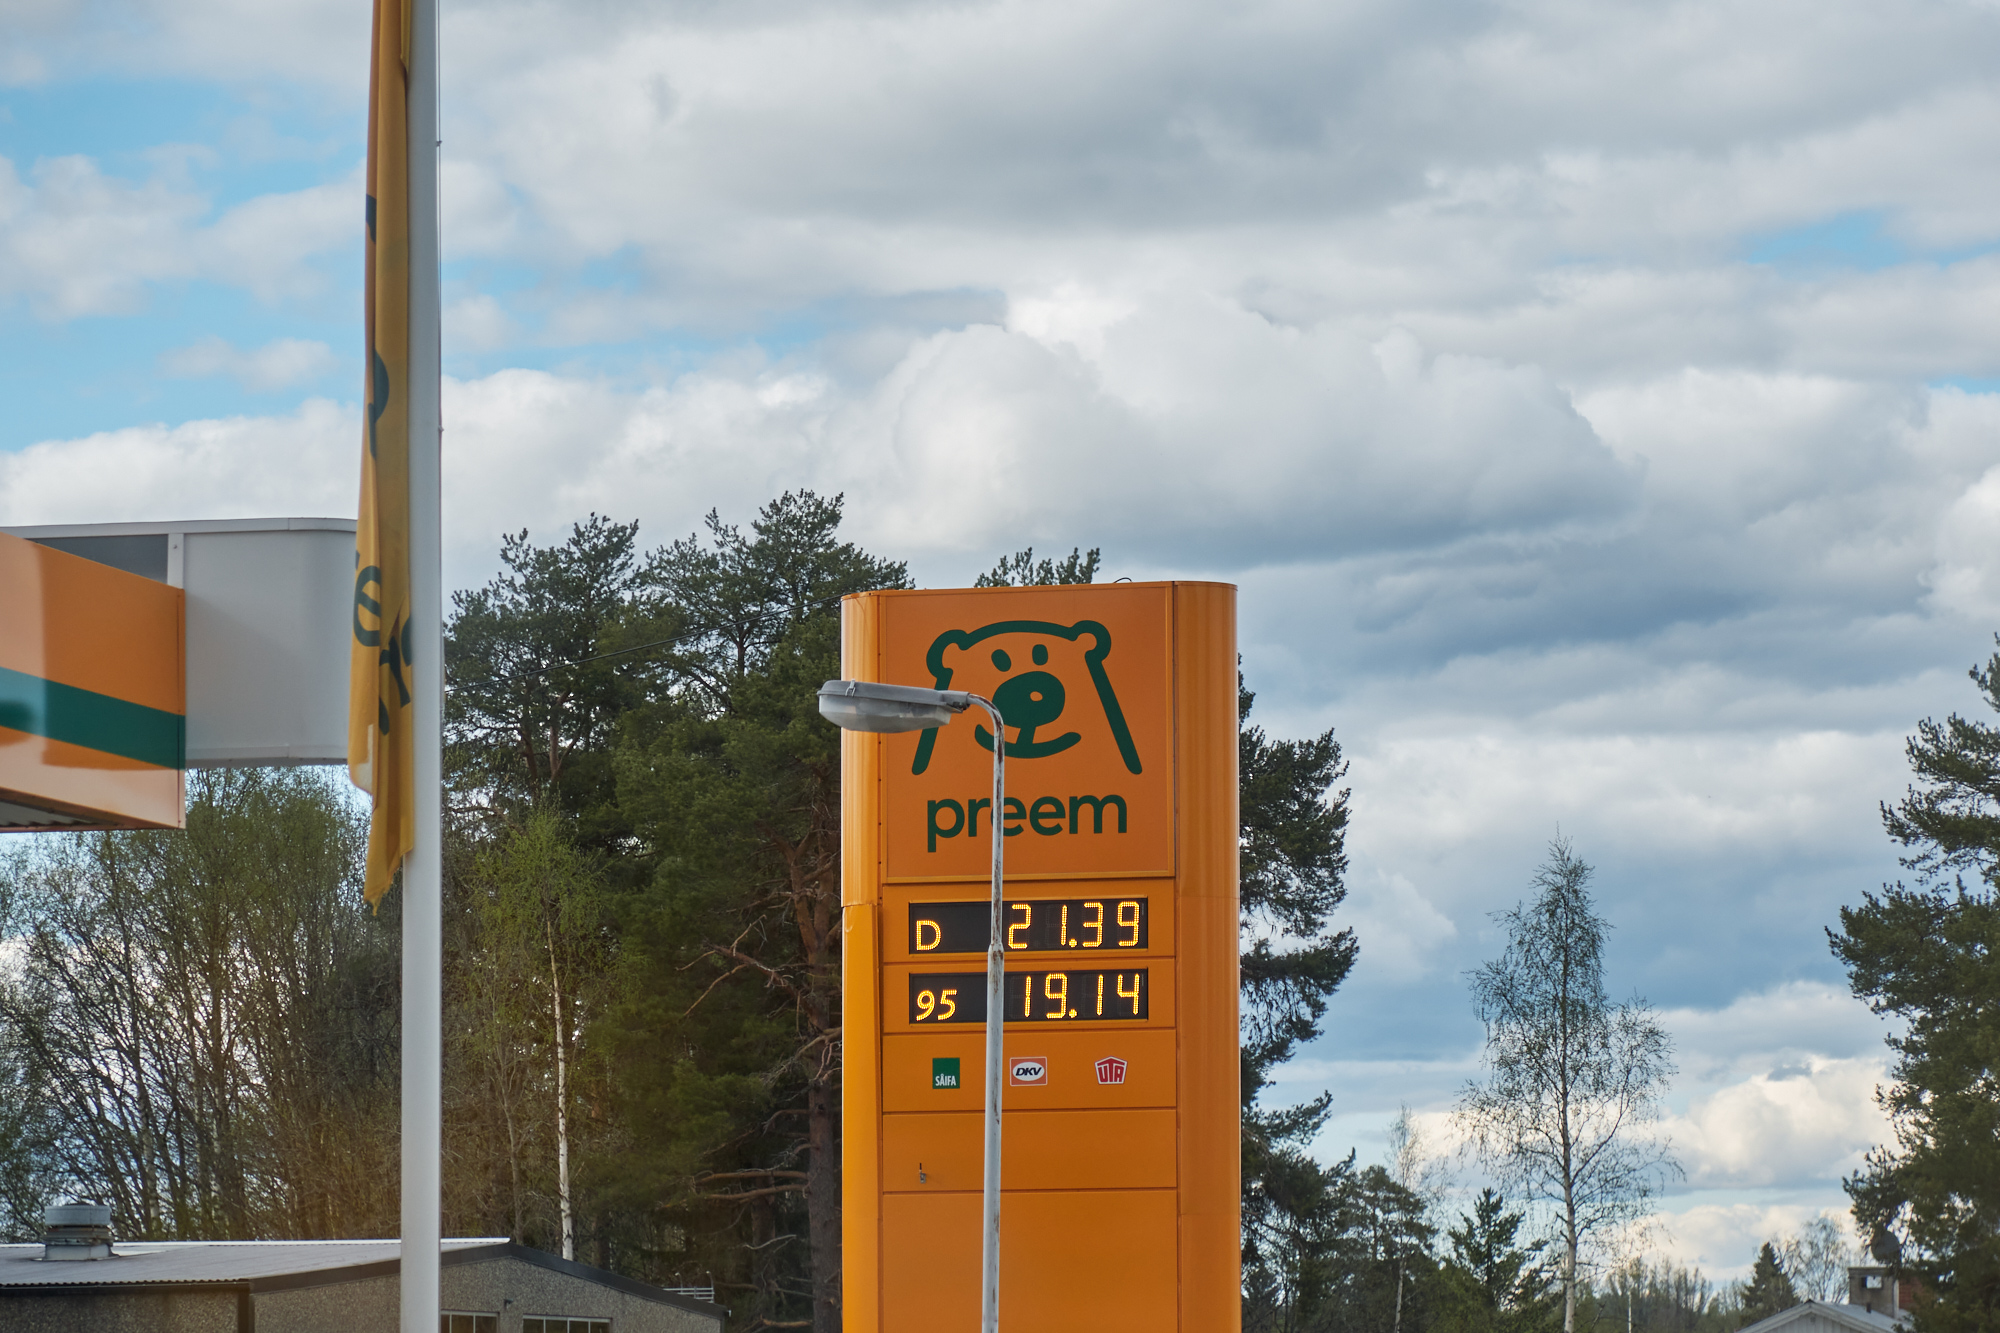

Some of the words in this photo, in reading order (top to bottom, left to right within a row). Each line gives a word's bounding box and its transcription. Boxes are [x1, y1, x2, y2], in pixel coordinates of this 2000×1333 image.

[927, 794, 1127, 853] preem
[916, 919, 941, 951] D
[1007, 901, 1140, 950] 21.39
[916, 989, 957, 1021] 95
[1024, 973, 1140, 1019] 19.14
[935, 1073, 957, 1086] SÅIFA
[1015, 1066, 1042, 1077] DKV
[1096, 1058, 1126, 1083] UTA
